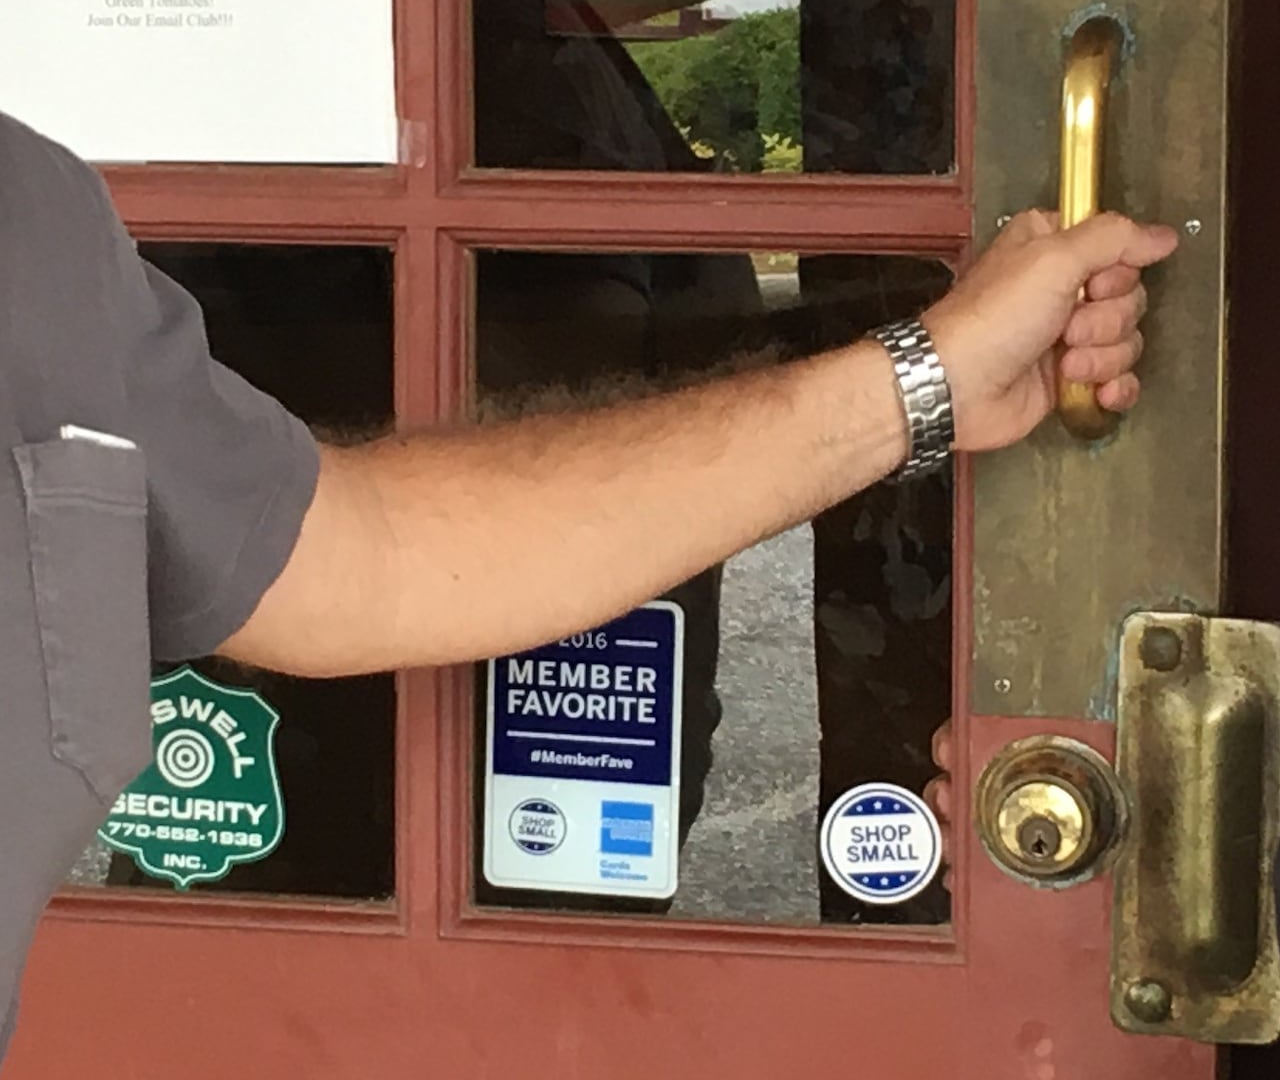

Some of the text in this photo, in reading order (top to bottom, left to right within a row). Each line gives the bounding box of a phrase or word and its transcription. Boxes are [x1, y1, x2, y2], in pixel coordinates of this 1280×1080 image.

[88, 13, 113, 27] Join
[117, 13, 141, 27] Our
[145, 13, 182, 28] Email
[508, 658, 657, 694] MEMBER
[508, 689, 656, 723] FAVORITE
[151, 695, 255, 779] SWELL
[530, 750, 633, 770] #MemberFave
[111, 792, 268, 826] SECURITY
[851, 824, 911, 843] SHOP
[847, 844, 919, 863] SMALL
